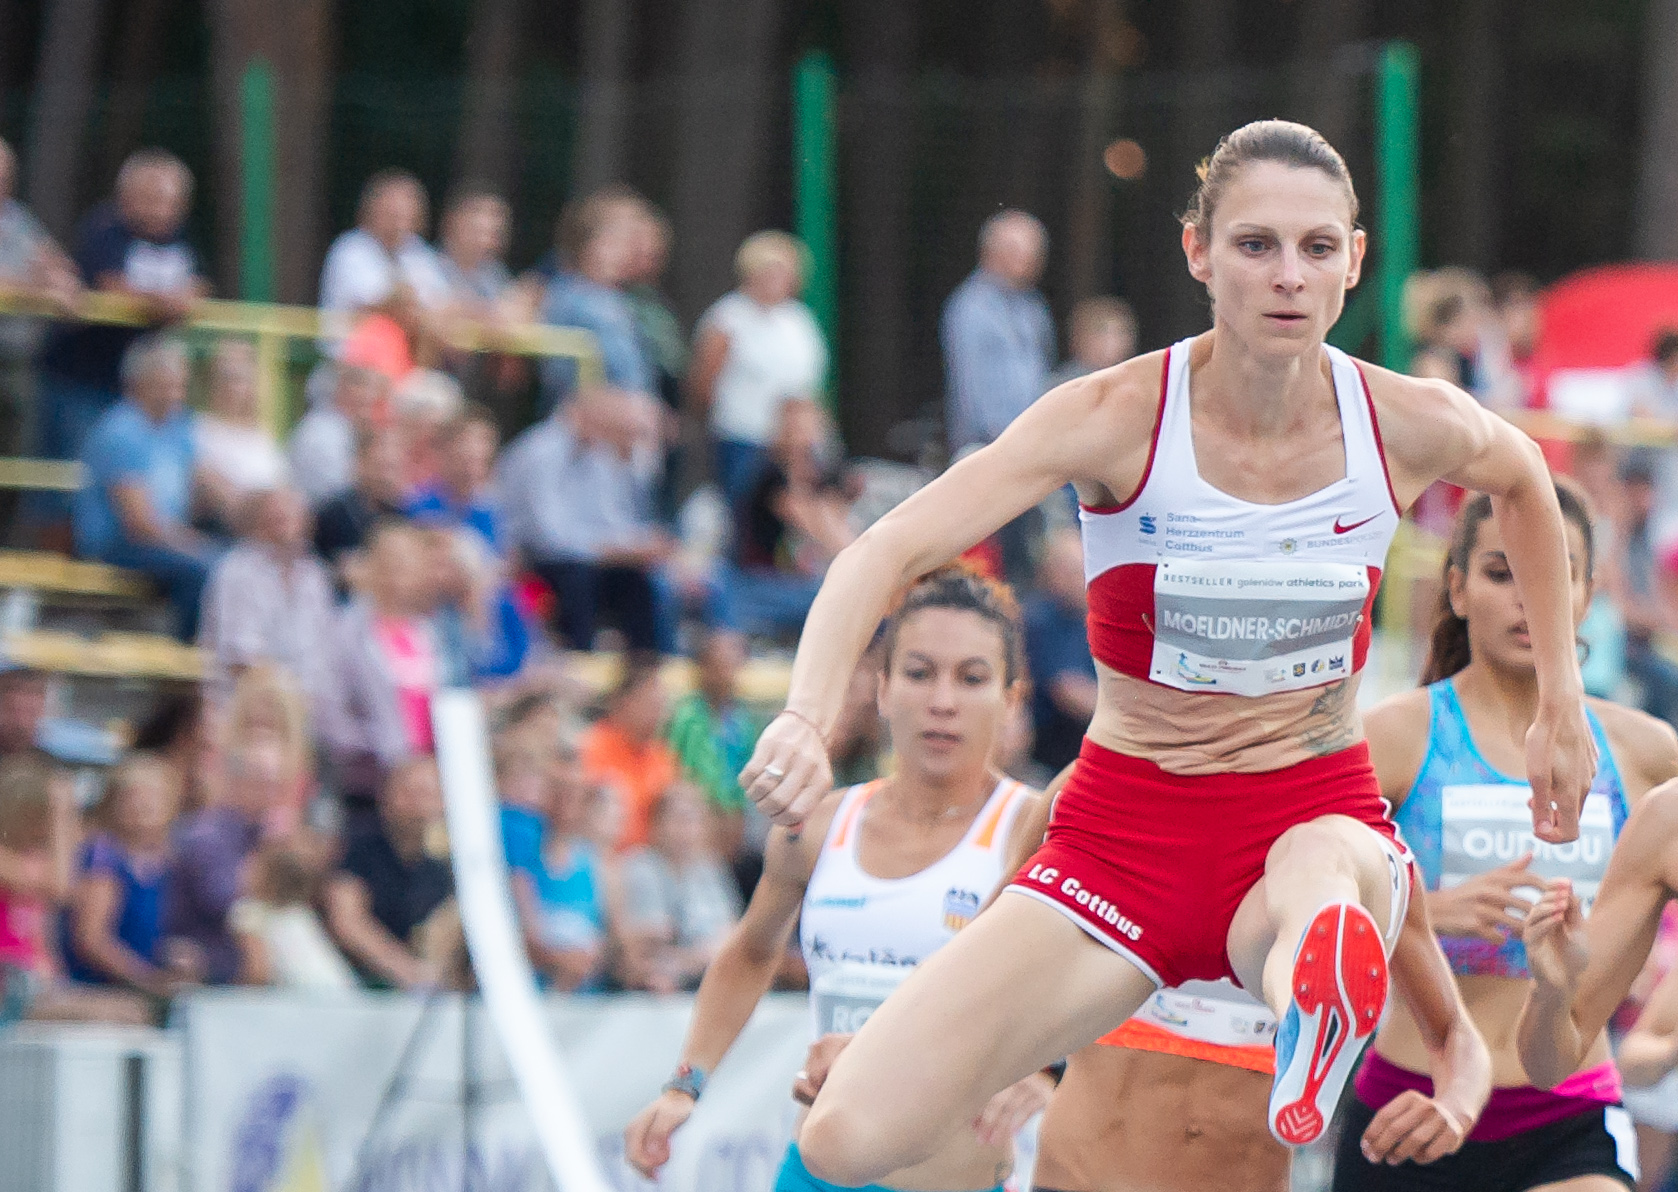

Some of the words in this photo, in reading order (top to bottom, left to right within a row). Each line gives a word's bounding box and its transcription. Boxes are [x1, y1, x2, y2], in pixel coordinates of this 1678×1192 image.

[1166, 527, 1245, 539] Herzzentrum
[1165, 540, 1213, 553] Cottbus
[1163, 573, 1233, 586] BESTSELLER
[1287, 577, 1335, 588] athletics
[1338, 578, 1365, 589] park
[1163, 609, 1361, 641] MOELDNER-SCHMIDT
[1027, 863, 1060, 885] LC
[1060, 877, 1144, 942] Cottbus
